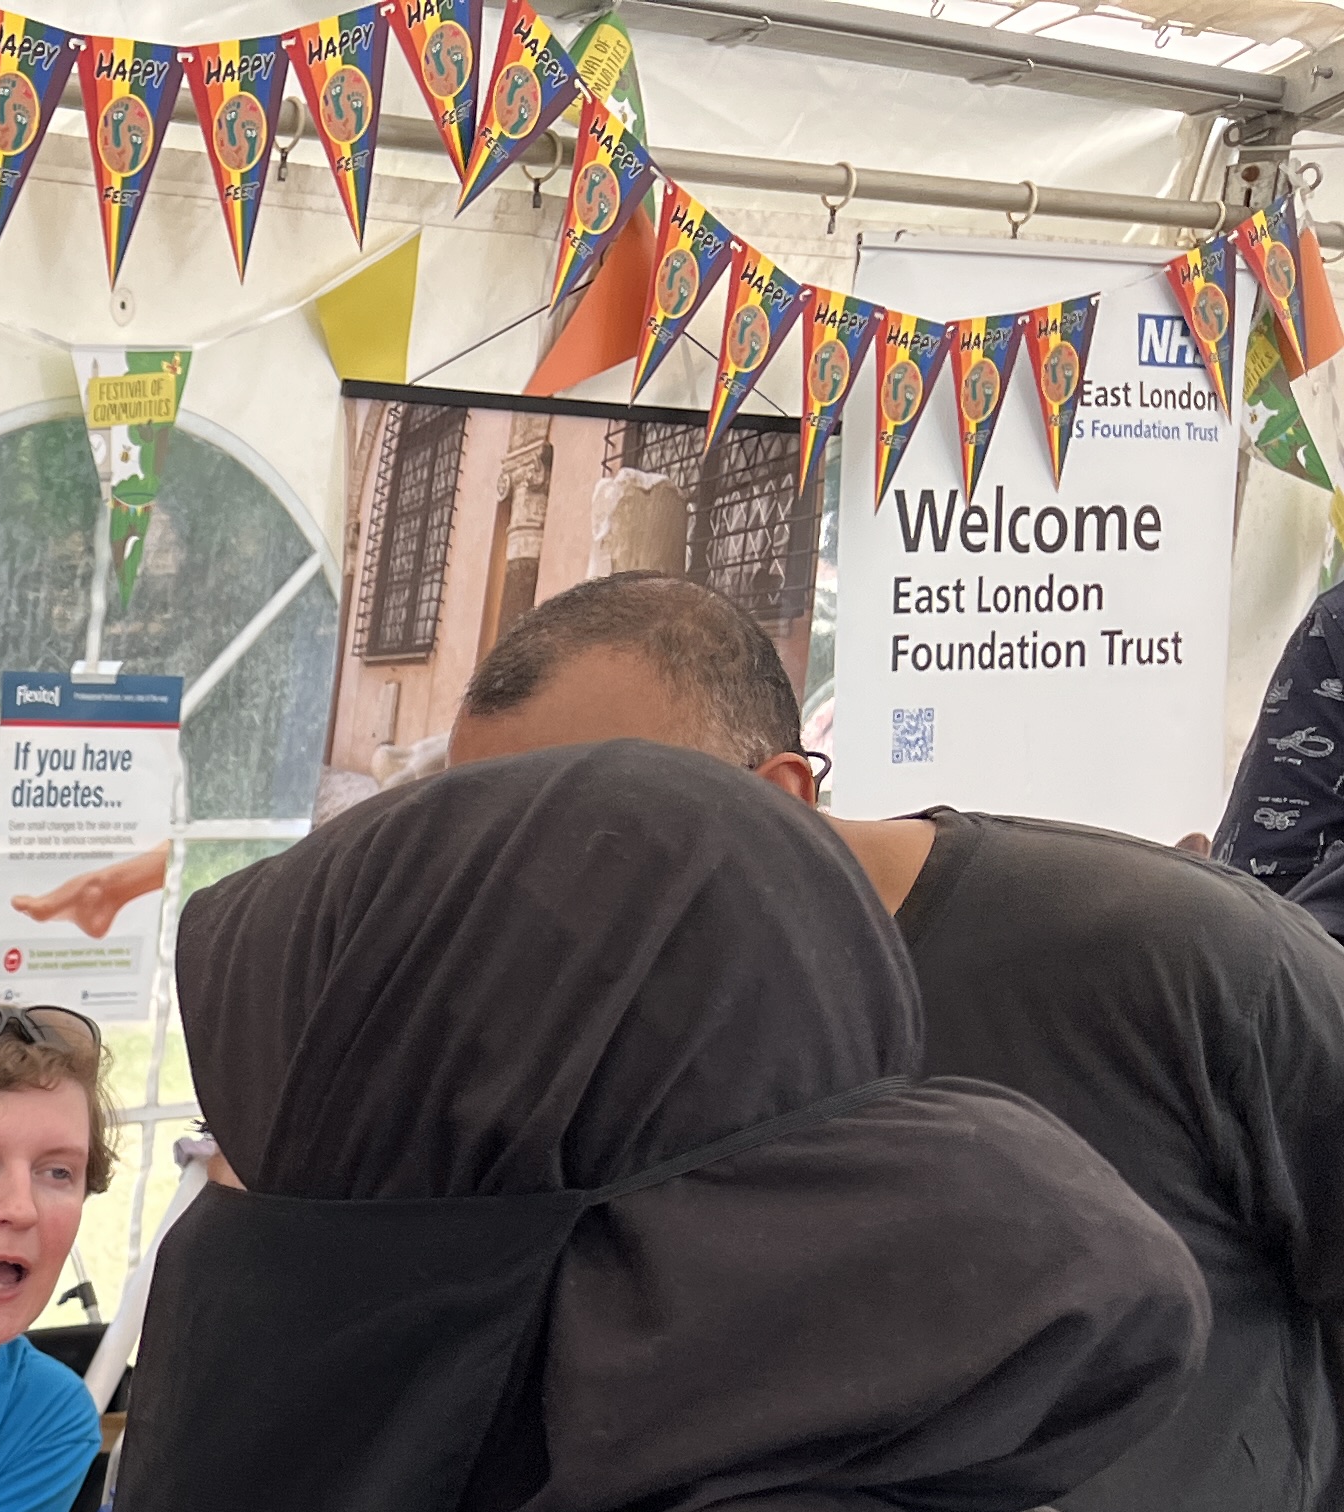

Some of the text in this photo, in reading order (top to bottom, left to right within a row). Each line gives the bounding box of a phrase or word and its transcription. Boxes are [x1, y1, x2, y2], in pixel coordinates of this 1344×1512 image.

[307, 24, 374, 65] HAPPY
[513, 17, 568, 88] HAPPY
[95, 52, 168, 88] HAPPY
[204, 52, 275, 88] HAPPY
[336, 150, 369, 173] FEET
[589, 117, 644, 178] HAPPY
[102, 186, 140, 207] FEET
[224, 182, 260, 202] FEET
[670, 205, 724, 259] HAPPY
[740, 261, 795, 312] HAPPY
[814, 303, 868, 338] HAPPY
[1038, 308, 1088, 340] HAPPY
[887, 324, 941, 358] HAPPY
[961, 327, 1013, 350] HAPPY
[1140, 317, 1204, 365] NH
[98, 378, 164, 401] FESTIVAL OF
[1080, 380, 1218, 411] East London
[93, 398, 172, 422] COMMUNITIES
[1091, 419, 1180, 440] Foundation
[1185, 422, 1219, 442] Trust
[894, 485, 1162, 553] Welcome
[892, 574, 1104, 614] East London
[892, 630, 1183, 672] Foundation Trust
[14, 742, 133, 777] If you have
[12, 778, 123, 809] diabetes...
